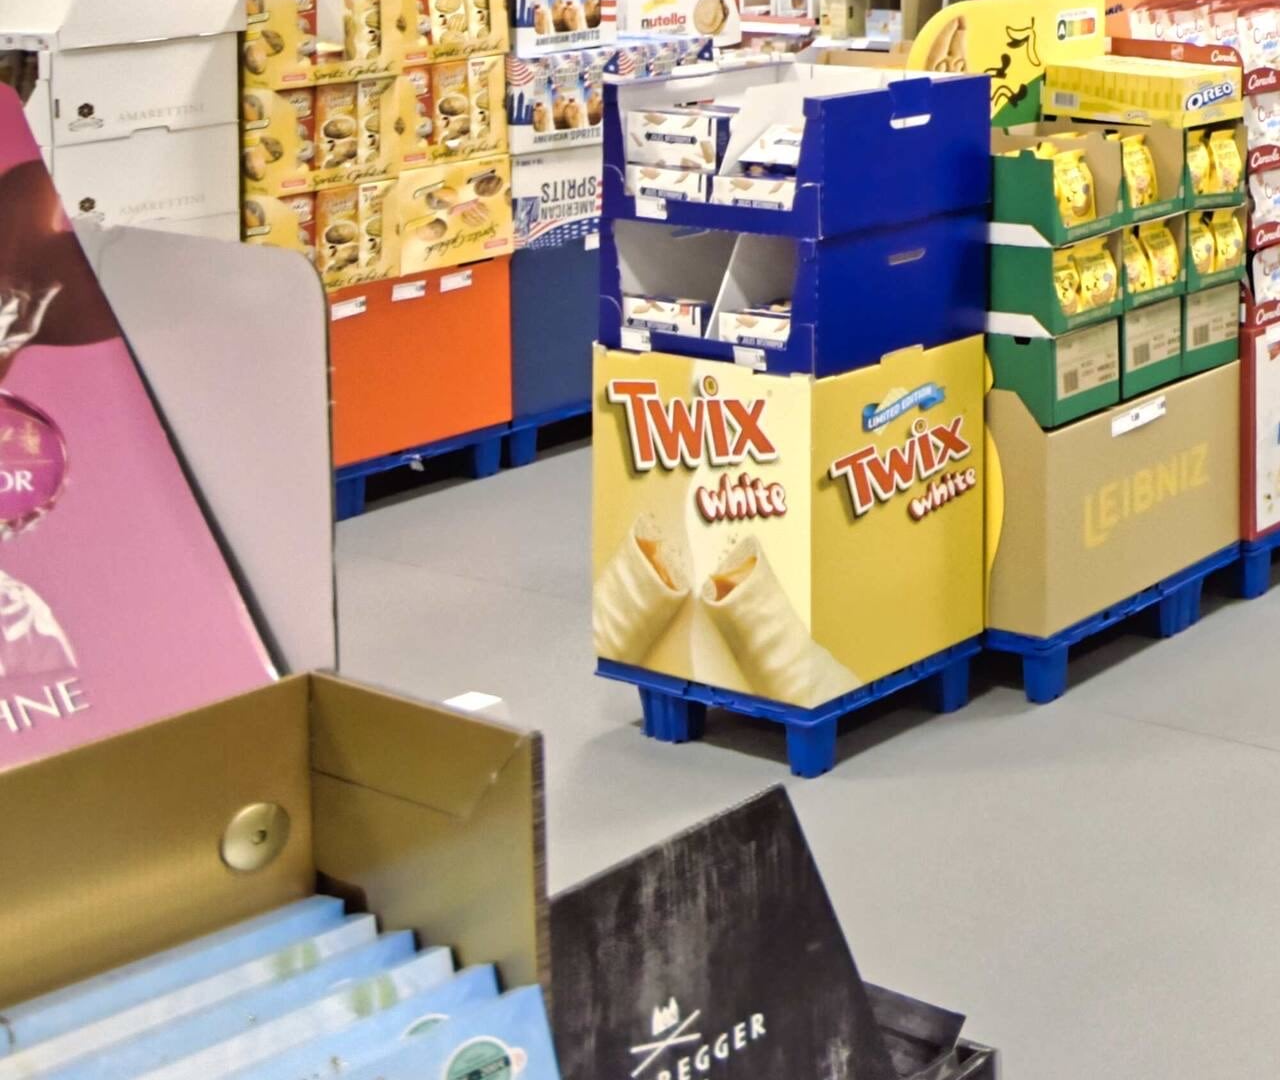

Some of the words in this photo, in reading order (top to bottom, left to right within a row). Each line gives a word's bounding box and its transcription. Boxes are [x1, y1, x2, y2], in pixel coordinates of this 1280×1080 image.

[571, 29, 600, 42] SPRITS
[641, 14, 686, 30] nutella
[1186, 82, 1233, 111] OREO
[119, 103, 205, 121] AMARETTINI
[570, 128, 601, 141] SPRITS
[541, 176, 597, 204] SPRITS
[541, 200, 596, 220] AMERICAN
[867, 403, 899, 428] LIMITED
[899, 385, 933, 412] EDITION
[612, 376, 777, 470] Twix
[831, 417, 970, 517] Twix
[696, 472, 787, 522] white
[907, 468, 976, 520] white
[1085, 443, 1208, 548] LEIBNIZ
